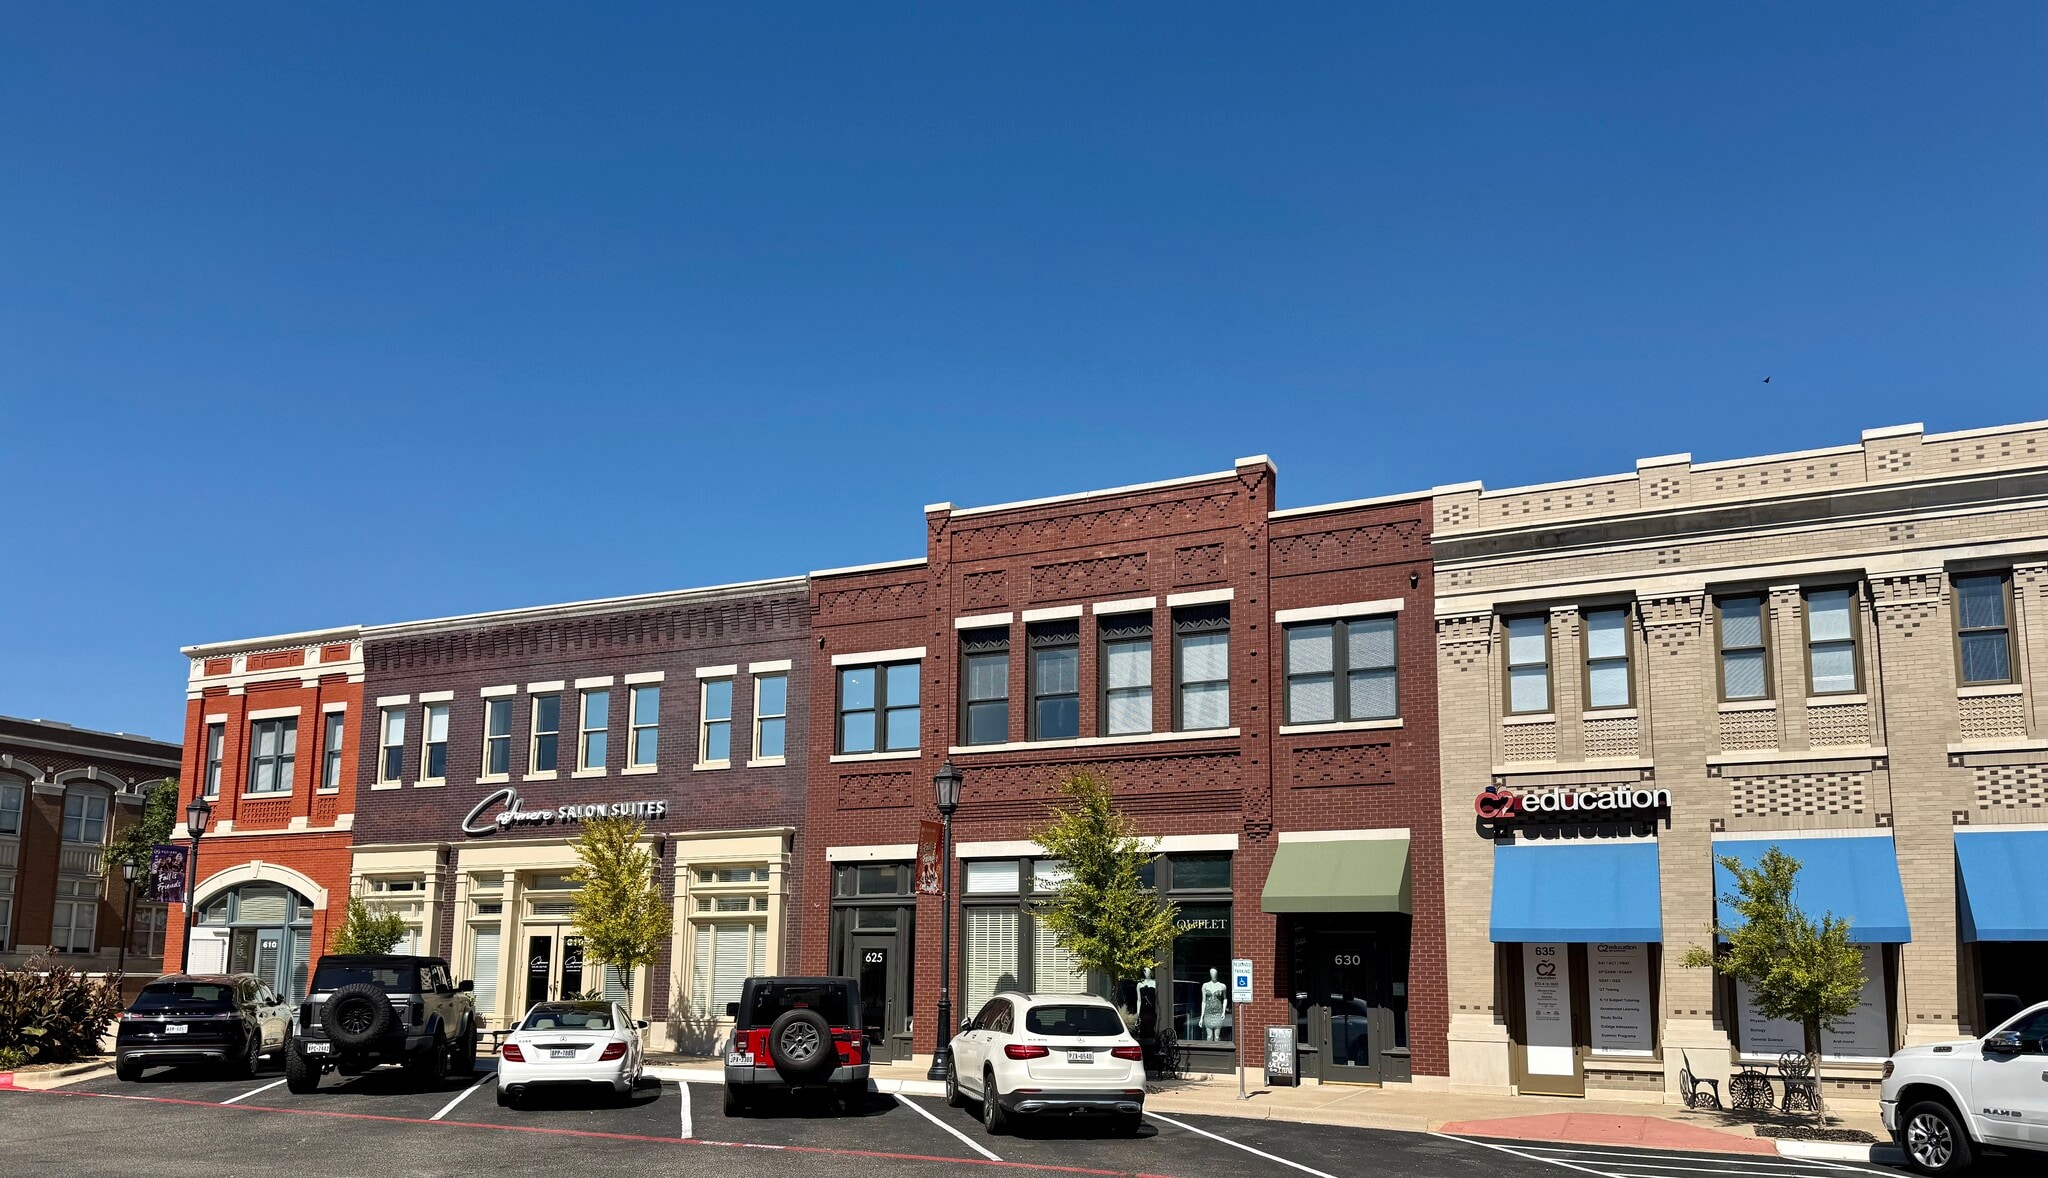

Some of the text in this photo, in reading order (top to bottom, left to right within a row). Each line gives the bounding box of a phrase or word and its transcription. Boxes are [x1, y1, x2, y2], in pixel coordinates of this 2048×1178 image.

[1475, 784, 1671, 818] C2 education
[462, 788, 671, 833] Cashmere SALON SUITES
[1535, 946, 1555, 956] 635
[865, 952, 883, 962] 625
[1335, 955, 1361, 965] 630
[1536, 962, 1556, 977] C2
[1983, 1108, 2010, 1117] RAM
